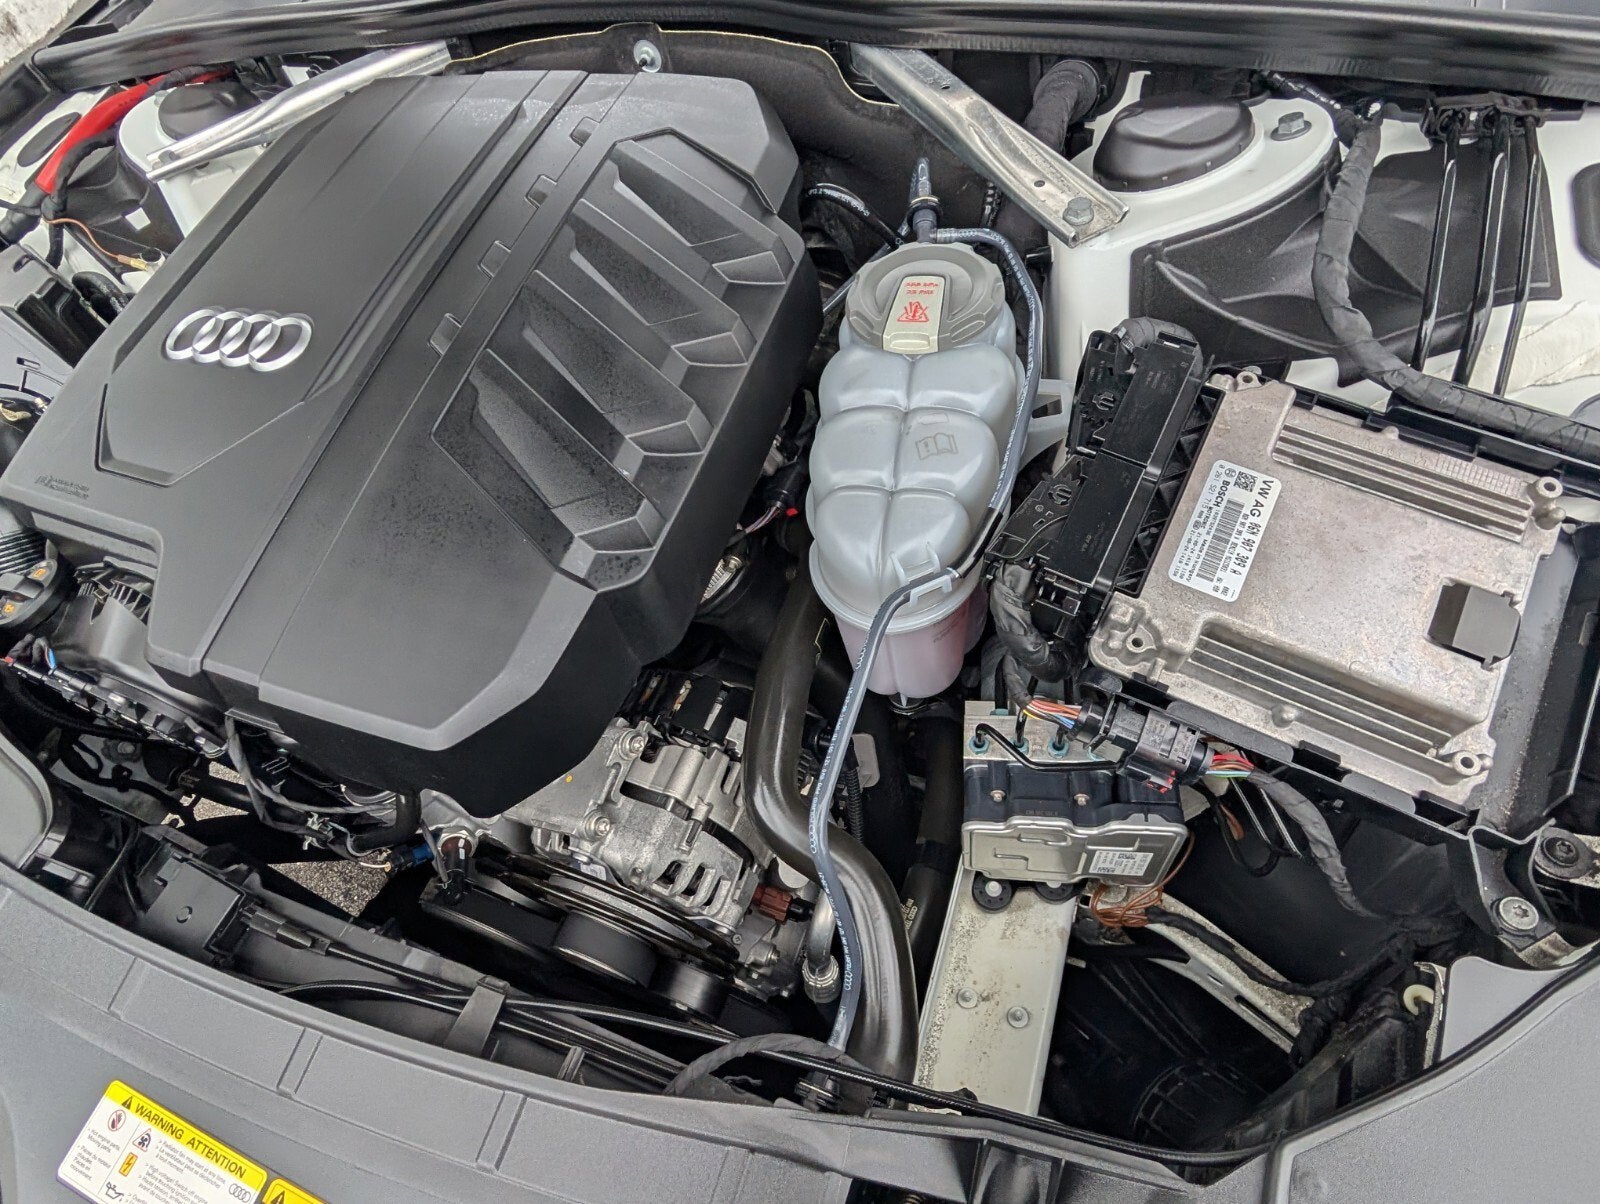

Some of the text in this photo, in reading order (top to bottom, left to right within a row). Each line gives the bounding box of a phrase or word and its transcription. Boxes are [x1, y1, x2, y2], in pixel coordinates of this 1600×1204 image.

[1213, 479, 1230, 507] BOSCH
[1257, 478, 1274, 499] VW
[1250, 499, 1264, 518] AG
[1198, 538, 1207, 553] Made
[1240, 537, 1255, 552] 907
[1233, 552, 1249, 568] 309
[1185, 559, 1198, 582] Hungary
[1230, 568, 1242, 576] A
[133, 1103, 247, 1178] WARNING ATTENTION
